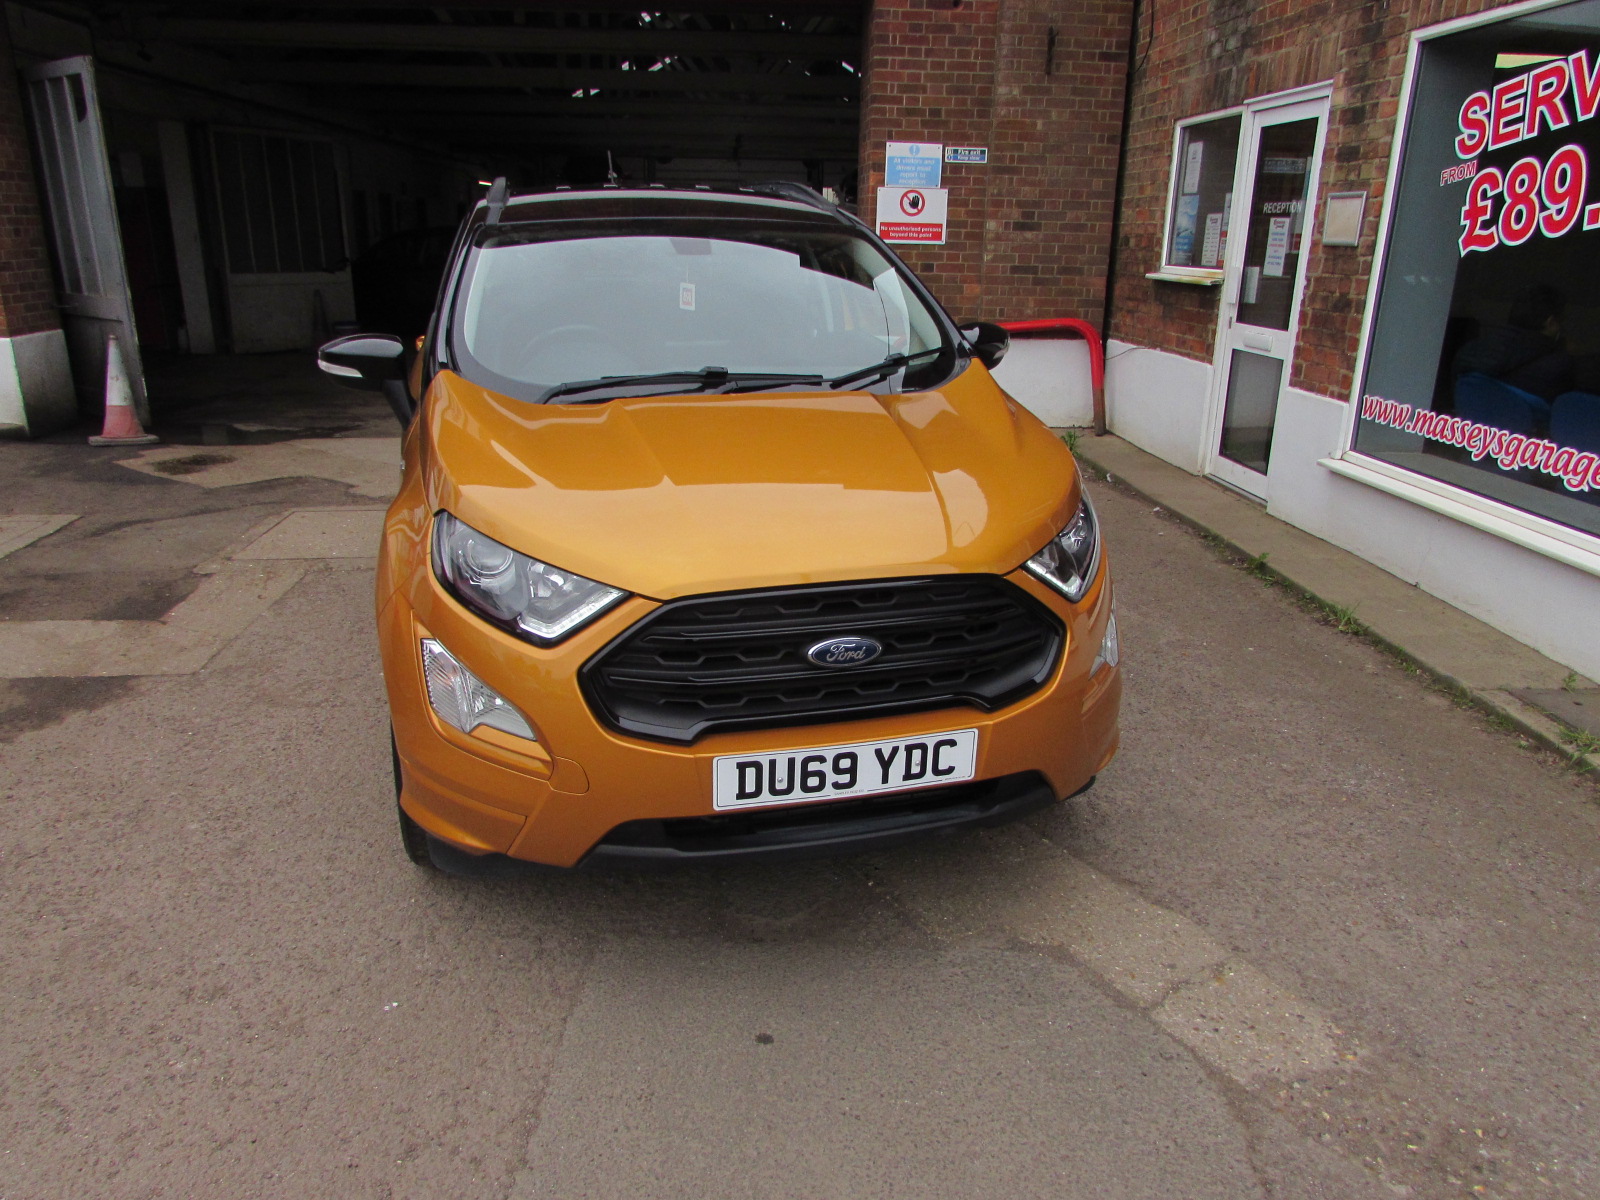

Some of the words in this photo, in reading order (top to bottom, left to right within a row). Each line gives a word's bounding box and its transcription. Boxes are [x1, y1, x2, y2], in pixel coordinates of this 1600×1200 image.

[1440, 160, 1478, 187] FROM
[1263, 201, 1302, 214] RECEPTION
[826, 643, 866, 663] Ford
[735, 751, 859, 801] DU69
[874, 738, 958, 785] YDC
